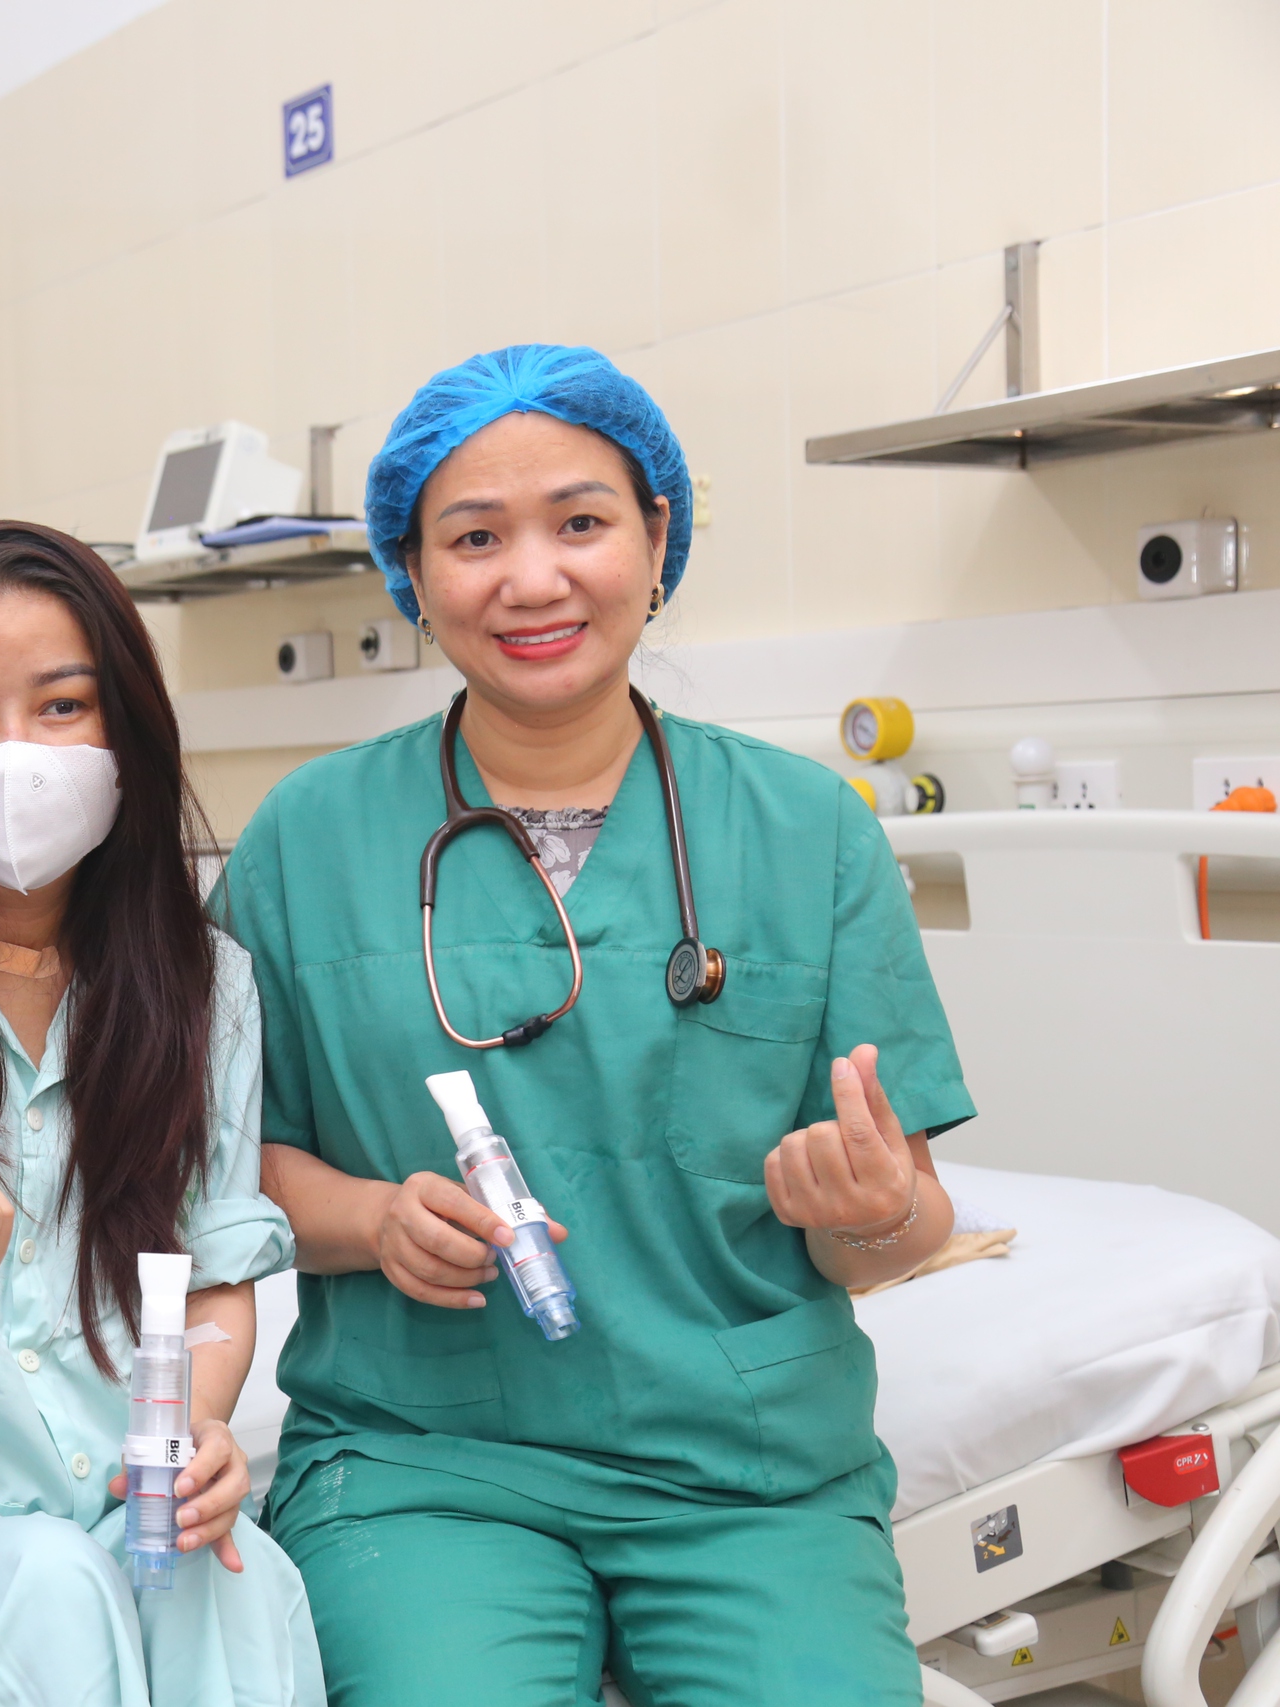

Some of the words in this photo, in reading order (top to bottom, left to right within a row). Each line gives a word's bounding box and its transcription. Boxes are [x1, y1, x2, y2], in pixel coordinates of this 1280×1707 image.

[289, 103, 325, 159] 25
[170, 1440, 180, 1465] BiG
[1176, 1456, 1193, 1467] CPR
[983, 1551, 989, 1560] 2
